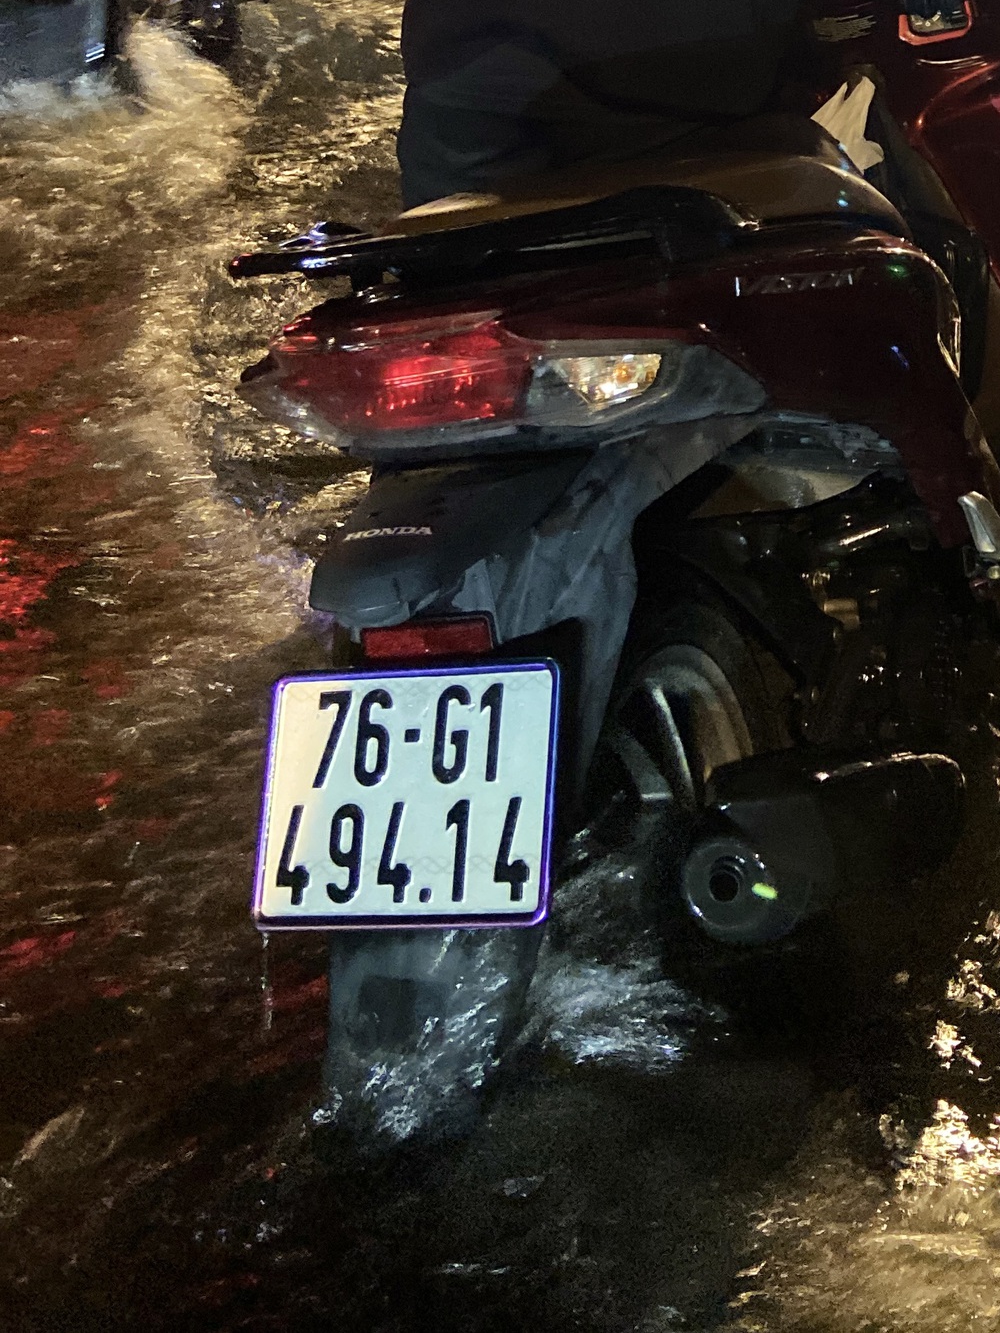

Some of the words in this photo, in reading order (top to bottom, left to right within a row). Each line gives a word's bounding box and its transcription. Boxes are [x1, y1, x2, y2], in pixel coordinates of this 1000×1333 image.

[343, 526, 432, 542] HONDA
[312, 682, 504, 789] 76-G1
[275, 796, 531, 906] 494.14
